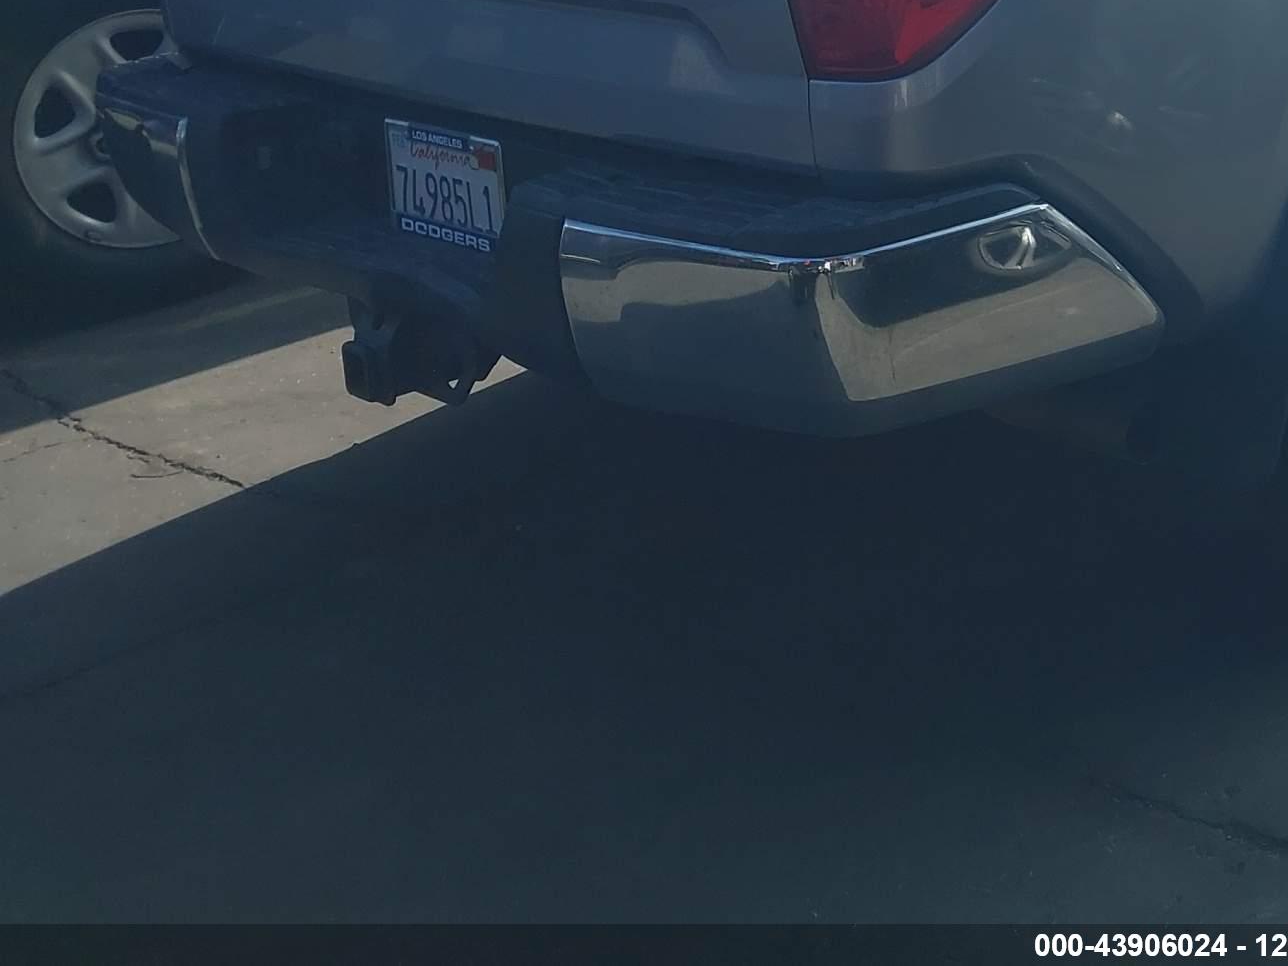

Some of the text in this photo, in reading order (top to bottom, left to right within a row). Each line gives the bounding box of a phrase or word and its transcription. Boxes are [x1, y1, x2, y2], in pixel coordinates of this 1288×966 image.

[411, 129, 427, 142] LOS
[428, 133, 464, 149] ANGELES
[410, 141, 471, 171] California
[395, 164, 494, 232] 74985L1
[400, 216, 491, 252] DODGERS
